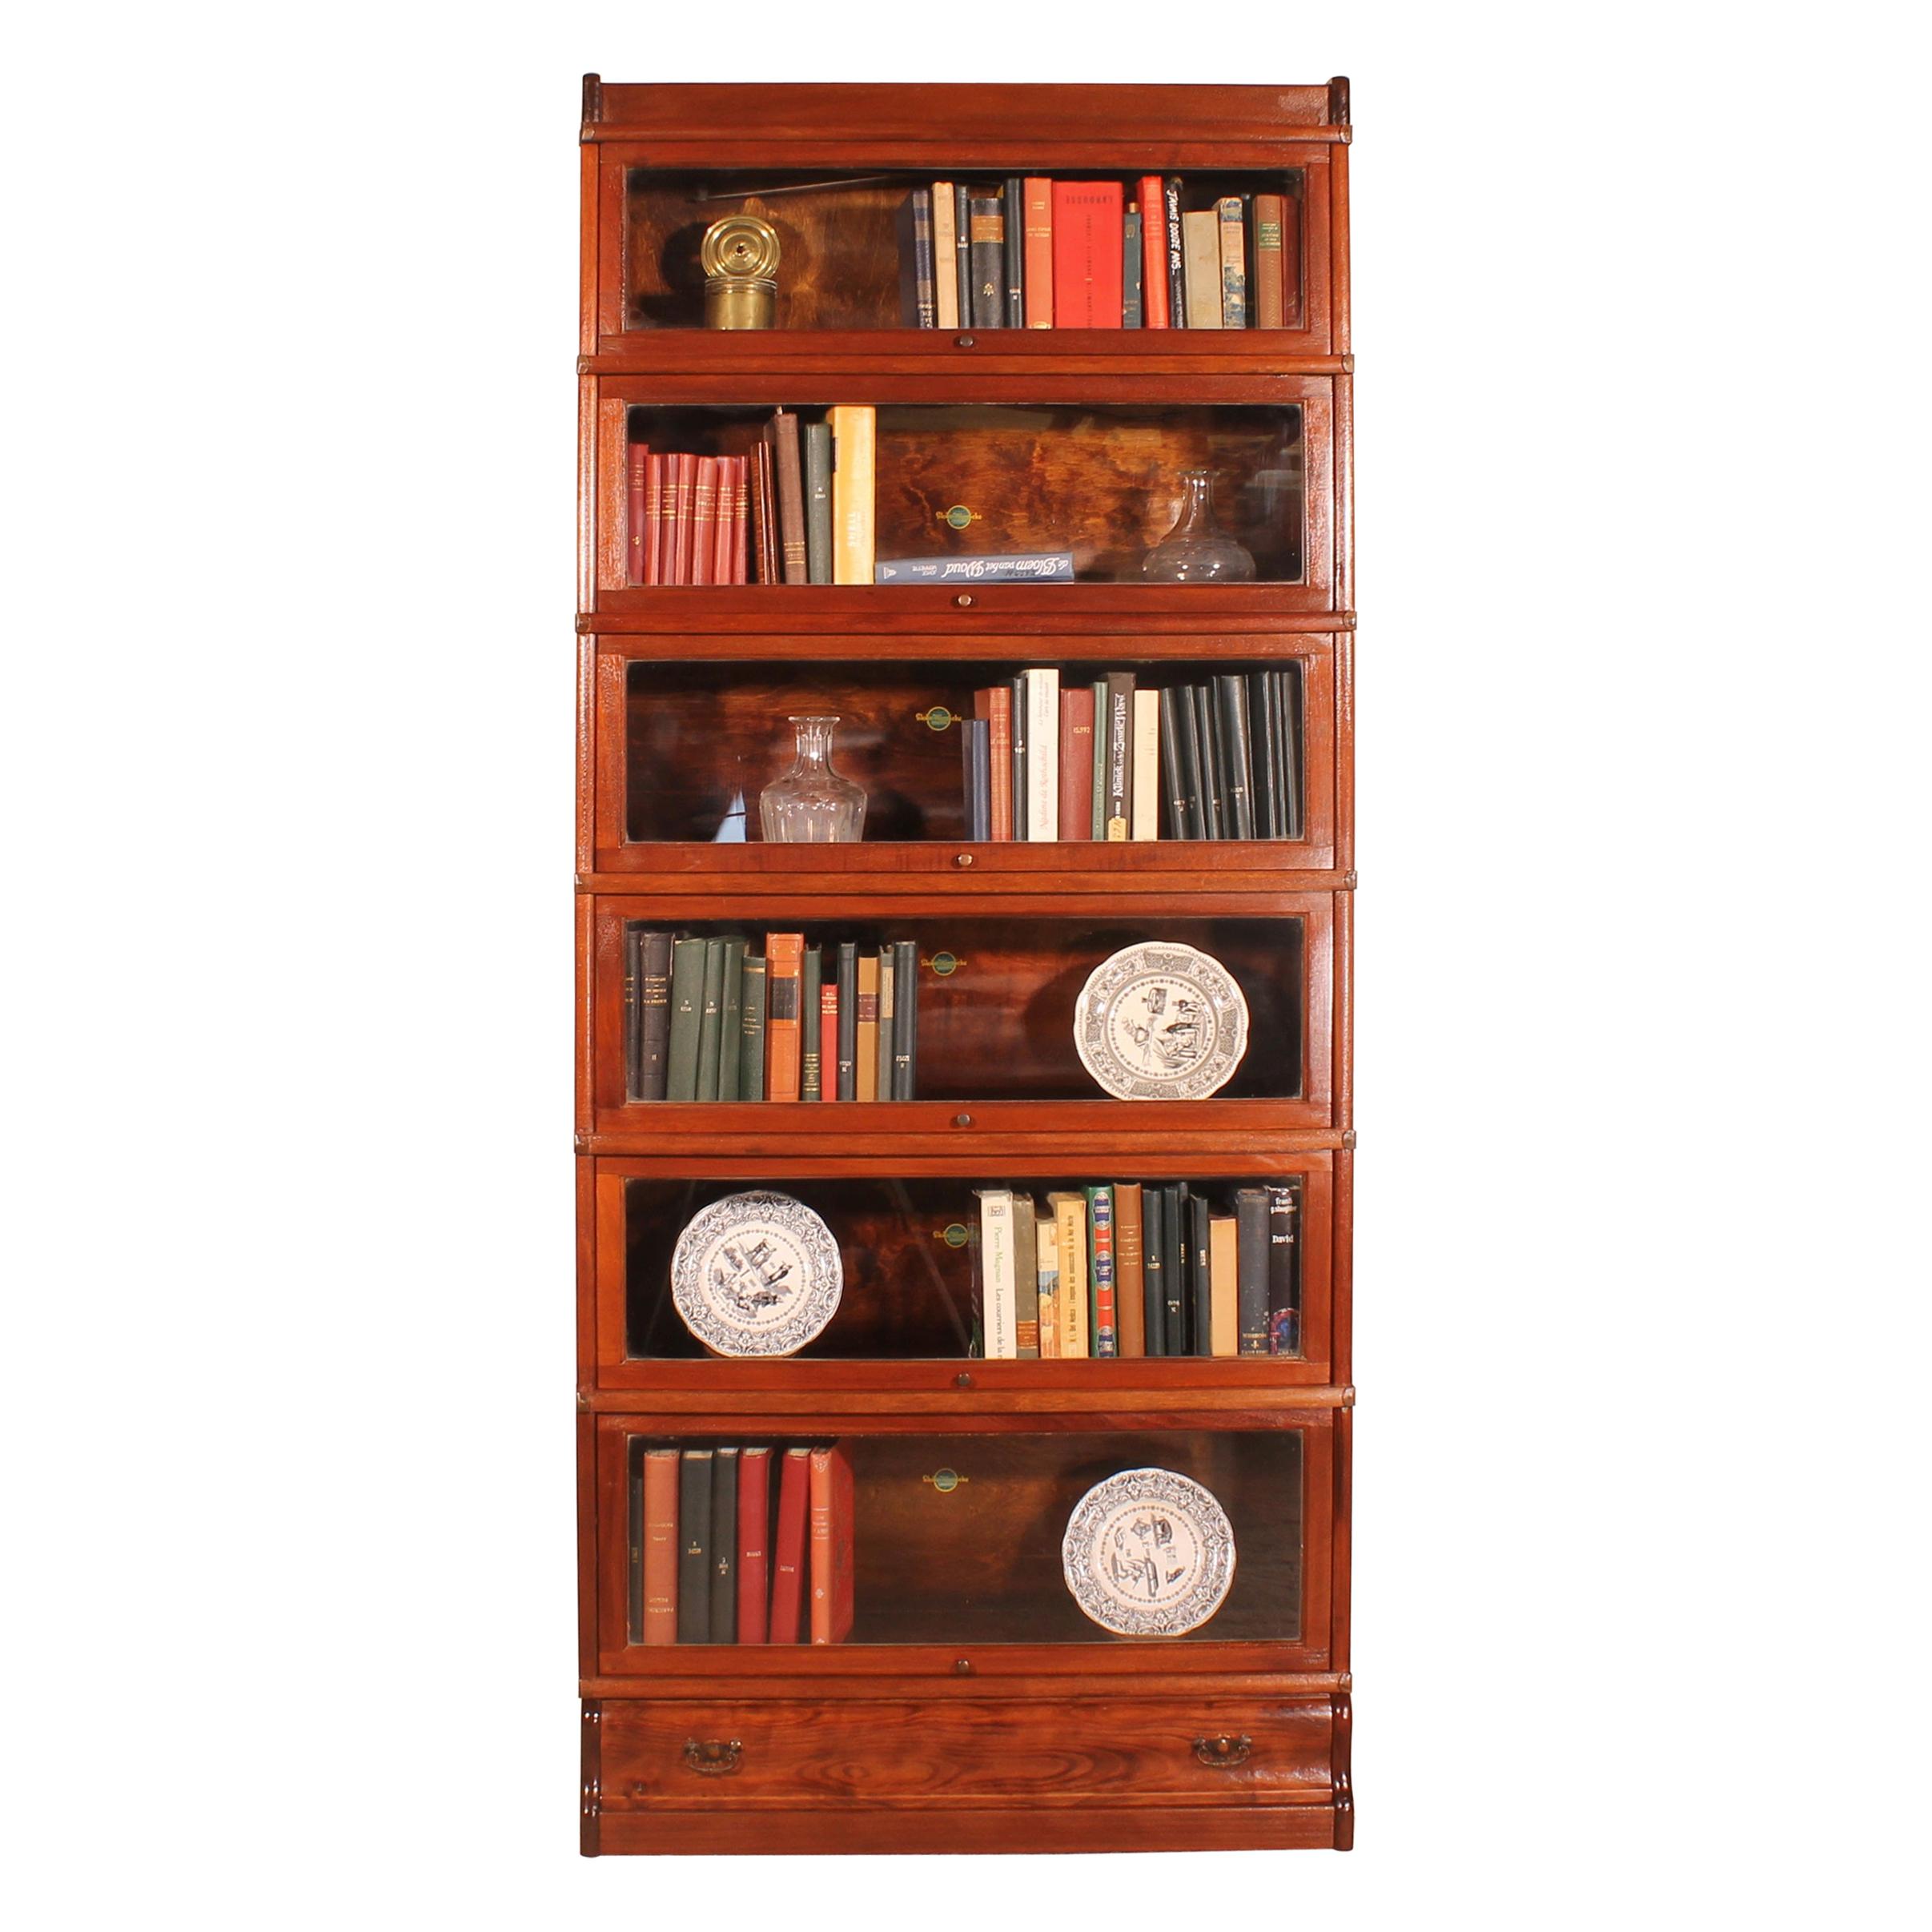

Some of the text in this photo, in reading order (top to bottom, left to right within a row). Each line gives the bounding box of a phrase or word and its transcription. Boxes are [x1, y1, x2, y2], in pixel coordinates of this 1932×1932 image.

[1169, 223, 1181, 251] DOUZE
[941, 560, 984, 578] Woud
[985, 561, 998, 573] het
[998, 560, 1015, 569] van
[1014, 556, 1060, 576] Bloem
[1058, 559, 1069, 569] de
[1038, 745, 1049, 830] Nadine de Rothschild
[1271, 1234, 1295, 1243] David
[994, 1226, 1003, 1283] Pierre Magnan
[995, 1288, 1004, 1301] Les
[996, 1303, 1005, 1335] courriers
[997, 1336, 1005, 1346] de
